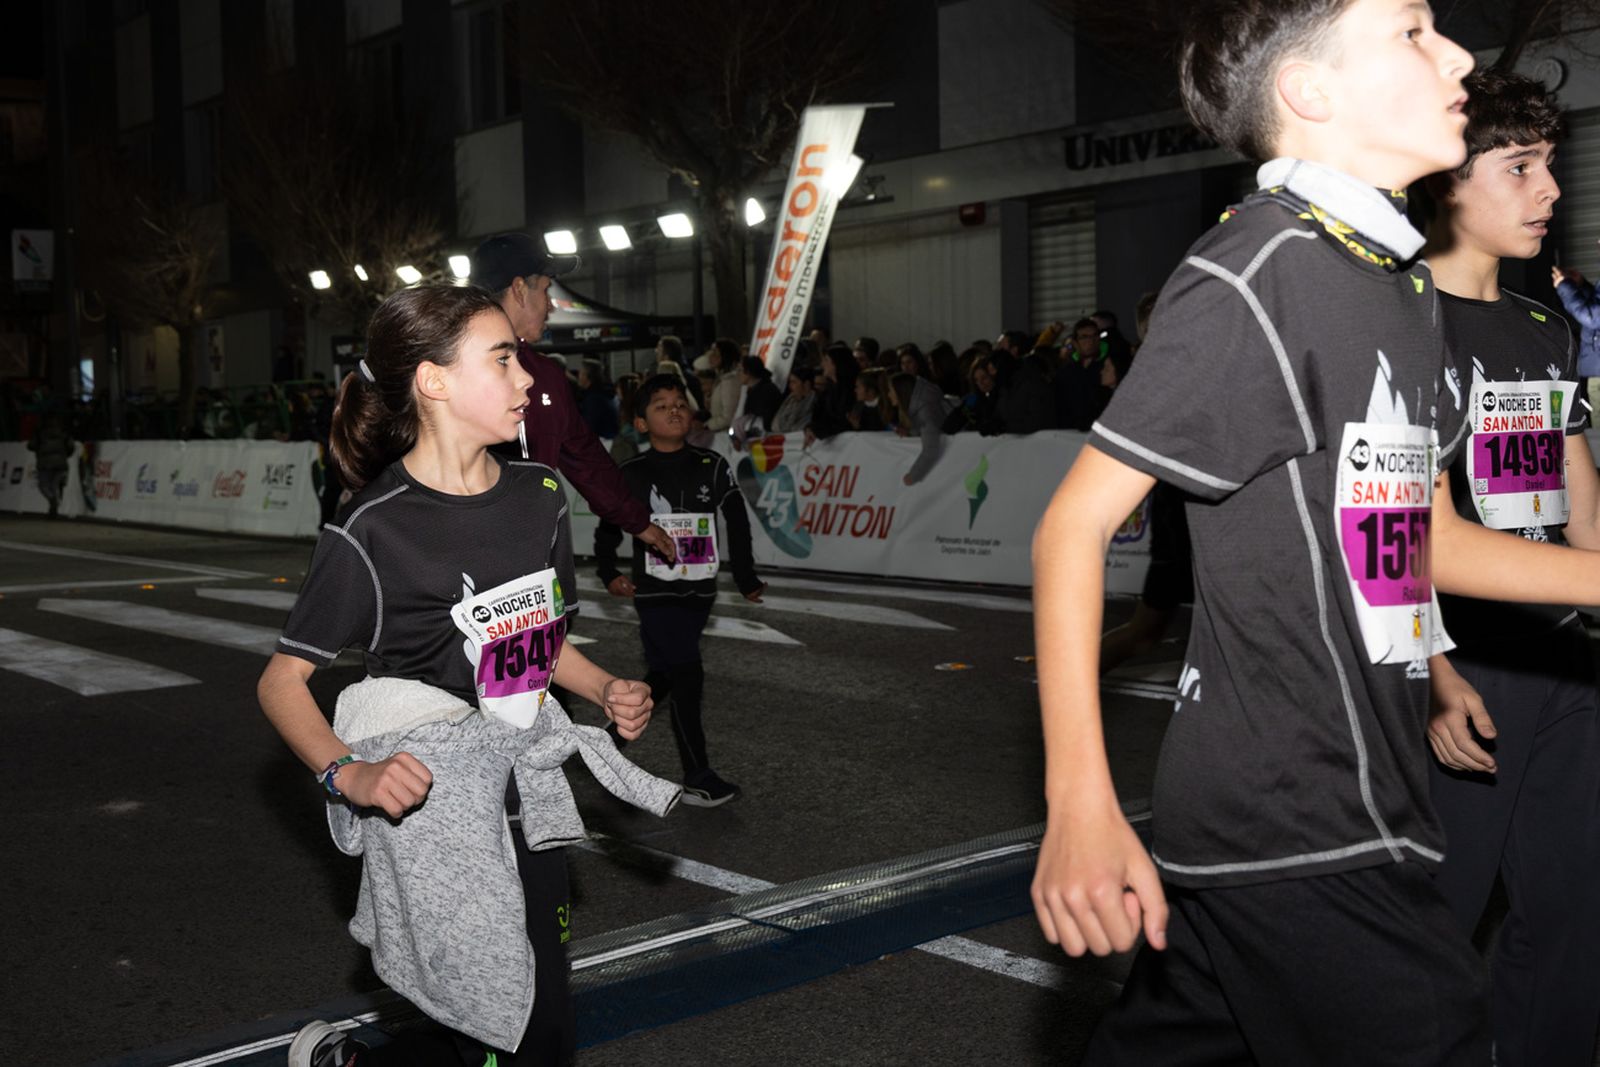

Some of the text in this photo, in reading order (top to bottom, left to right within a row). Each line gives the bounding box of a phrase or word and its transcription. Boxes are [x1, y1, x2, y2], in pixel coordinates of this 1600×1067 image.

[780, 303, 804, 360] obras
[1498, 397, 1542, 412] NOCHE DE
[1483, 416, 1508, 432] SAN
[1510, 411, 1543, 432] ANTÓN
[1374, 452, 1415, 473] NOCHE
[799, 464, 860, 498] SAN
[1352, 480, 1389, 505] SAN
[756, 478, 793, 529] 43
[794, 495, 895, 540] ANTÓN
[677, 537, 706, 557] 547
[493, 595, 534, 618] NOCHE
[535, 589, 547, 604] DE
[486, 618, 513, 640] SAN
[514, 605, 549, 632] ANTÓN
